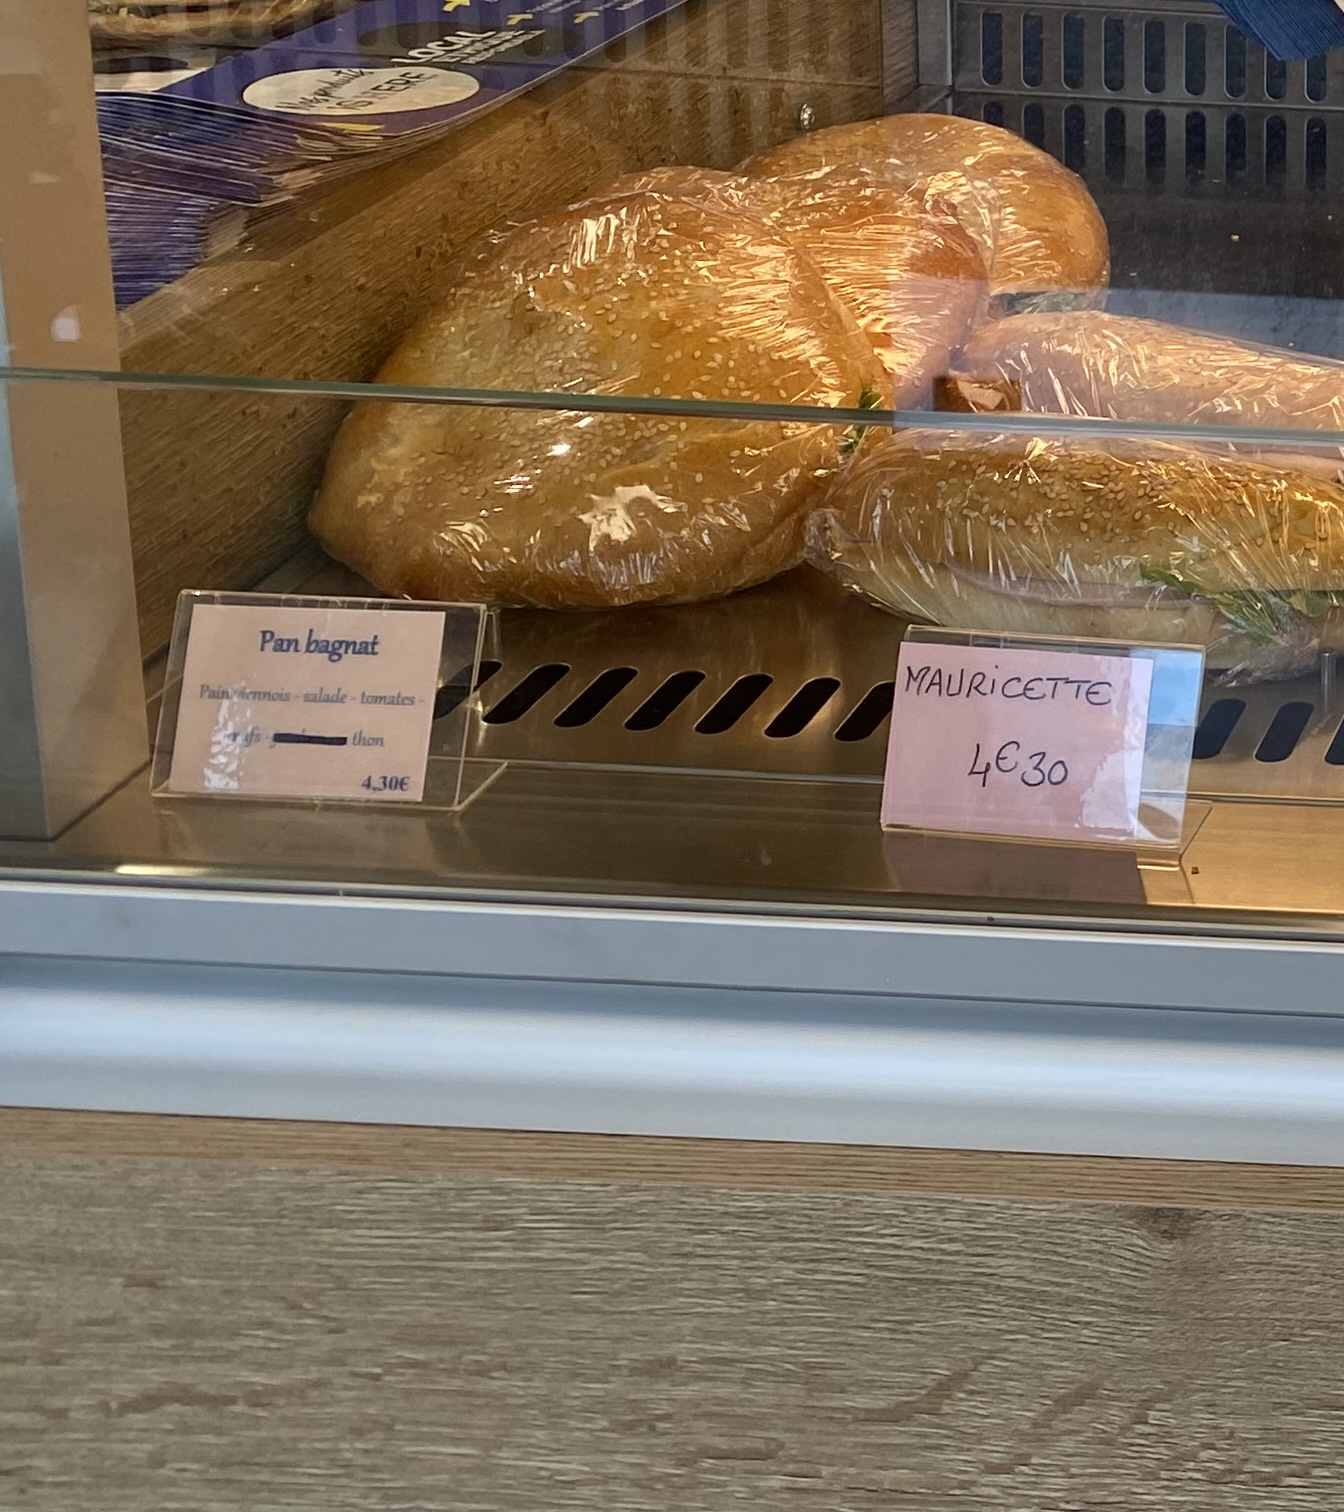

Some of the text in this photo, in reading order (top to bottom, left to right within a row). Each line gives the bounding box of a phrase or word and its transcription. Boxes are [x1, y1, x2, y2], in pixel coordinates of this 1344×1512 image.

[391, 29, 497, 64] LOCAL
[259, 627, 380, 662] Pan bagnat
[199, 683, 230, 701] Pain
[303, 688, 348, 705] salade
[360, 690, 416, 707] tomates
[351, 727, 385, 748] thon
[361, 774, 412, 794] 4,30€
